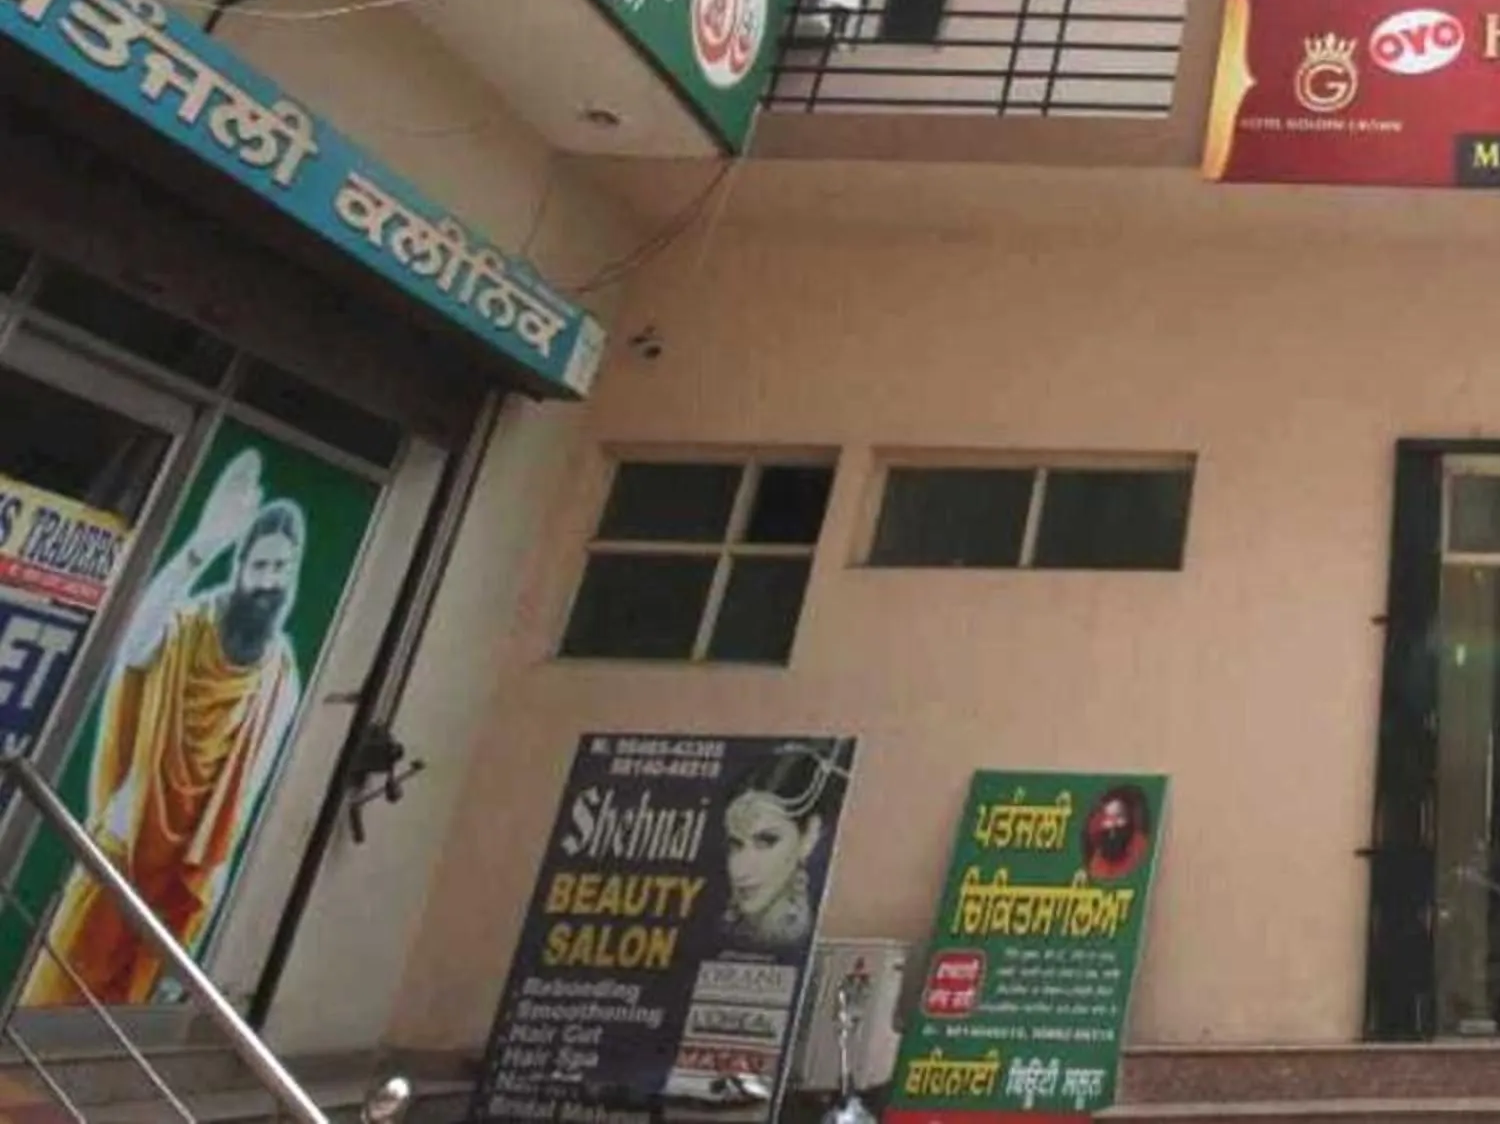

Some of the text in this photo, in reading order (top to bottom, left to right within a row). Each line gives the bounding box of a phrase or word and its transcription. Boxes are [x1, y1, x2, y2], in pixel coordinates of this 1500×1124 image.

[1373, 13, 1463, 69] OYO
[333, 171, 567, 357] ਕਲੀਨਿਕ
[561, 783, 711, 863] Shehnai
[974, 786, 1073, 850] ਪਤੰਜਲੀ
[545, 871, 707, 918] BEAUTY
[543, 925, 677, 967] SALON
